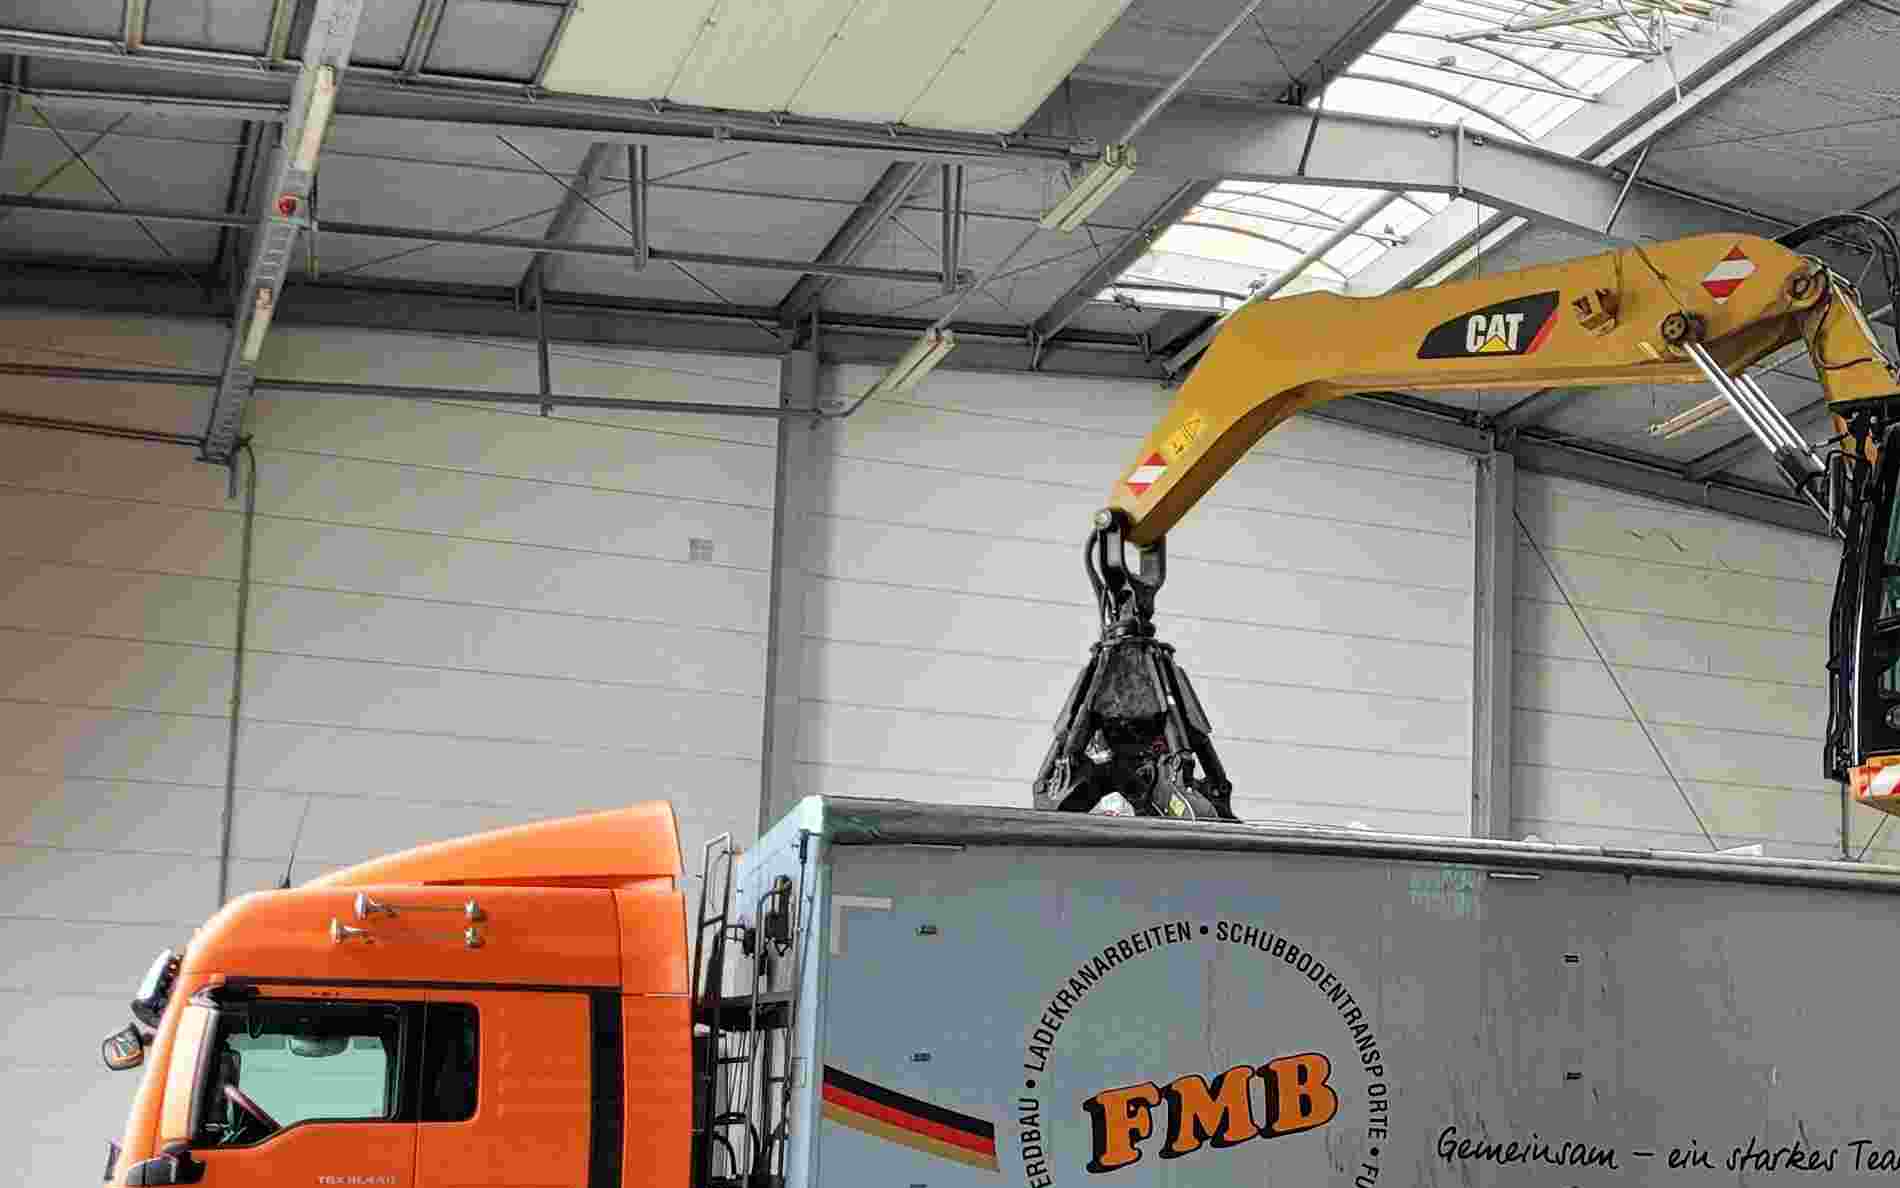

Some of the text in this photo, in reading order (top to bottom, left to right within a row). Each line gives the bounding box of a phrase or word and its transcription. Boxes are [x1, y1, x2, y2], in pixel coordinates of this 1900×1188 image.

[1466, 313, 1524, 353] CAT
[1024, 920, 1193, 1073] LADEKRANARBEITEN
[1215, 920, 1389, 1141] SCHUBBODENTRANSPORTE
[1082, 1051, 1339, 1175] FMB
[1438, 1126, 1618, 1169] Gemeinsam
[1668, 1139, 1715, 1168] ein
[1726, 1136, 1838, 1171] starkes
